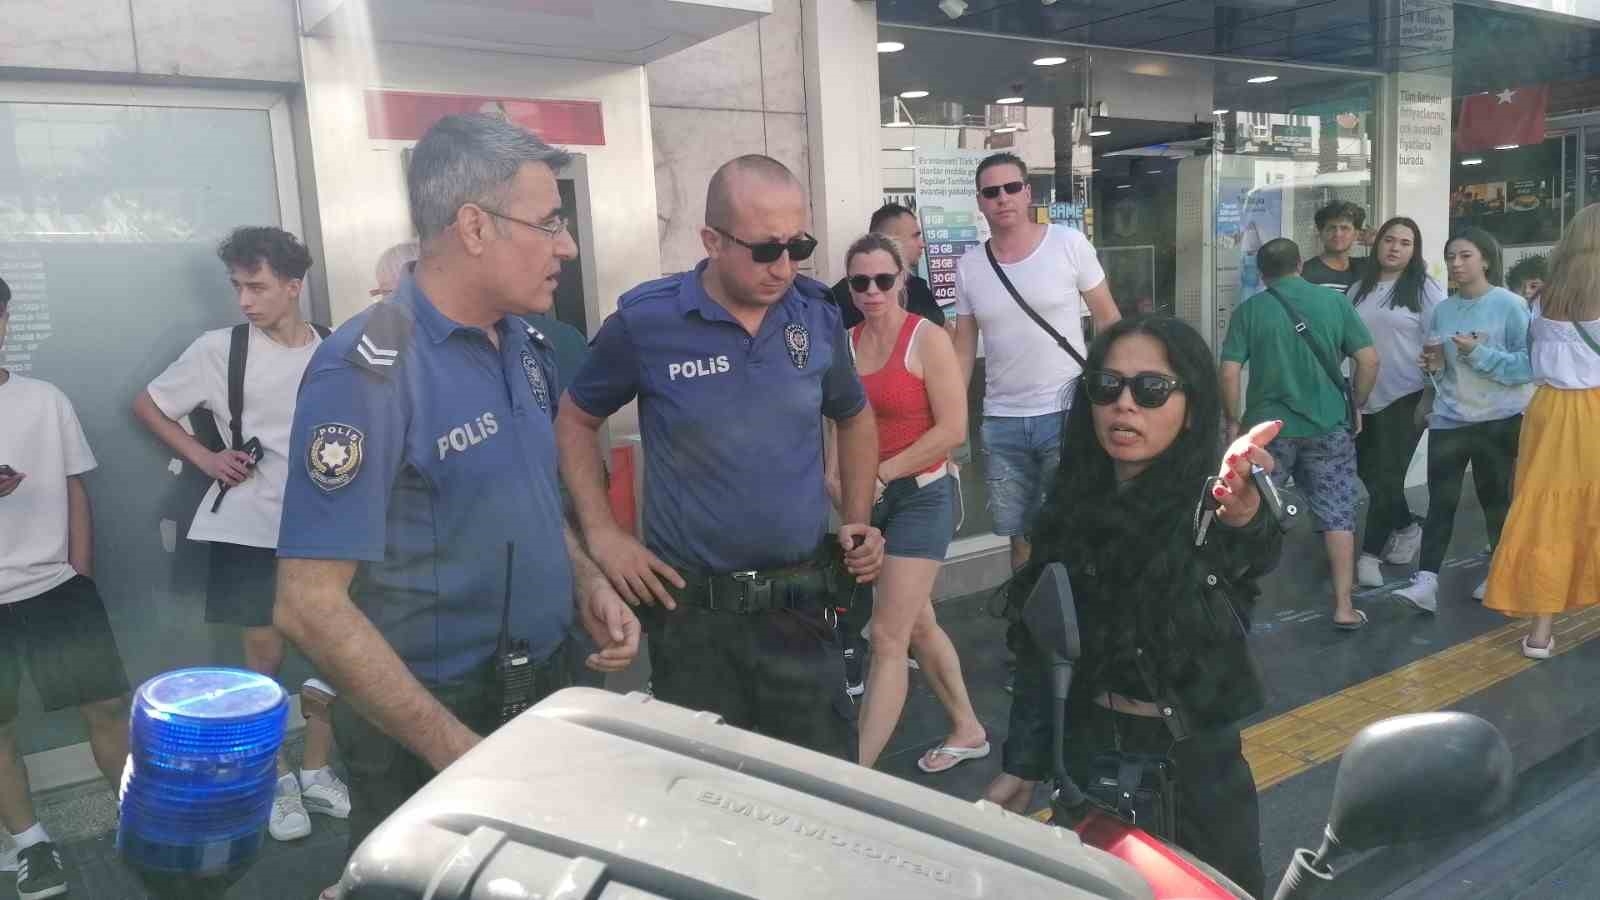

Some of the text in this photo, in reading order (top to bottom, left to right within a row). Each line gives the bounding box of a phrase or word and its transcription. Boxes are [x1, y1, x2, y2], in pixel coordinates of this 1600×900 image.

[940, 243, 953, 253] GB
[935, 287, 946, 297] 40
[700, 791, 953, 883] BMW Motorrad
